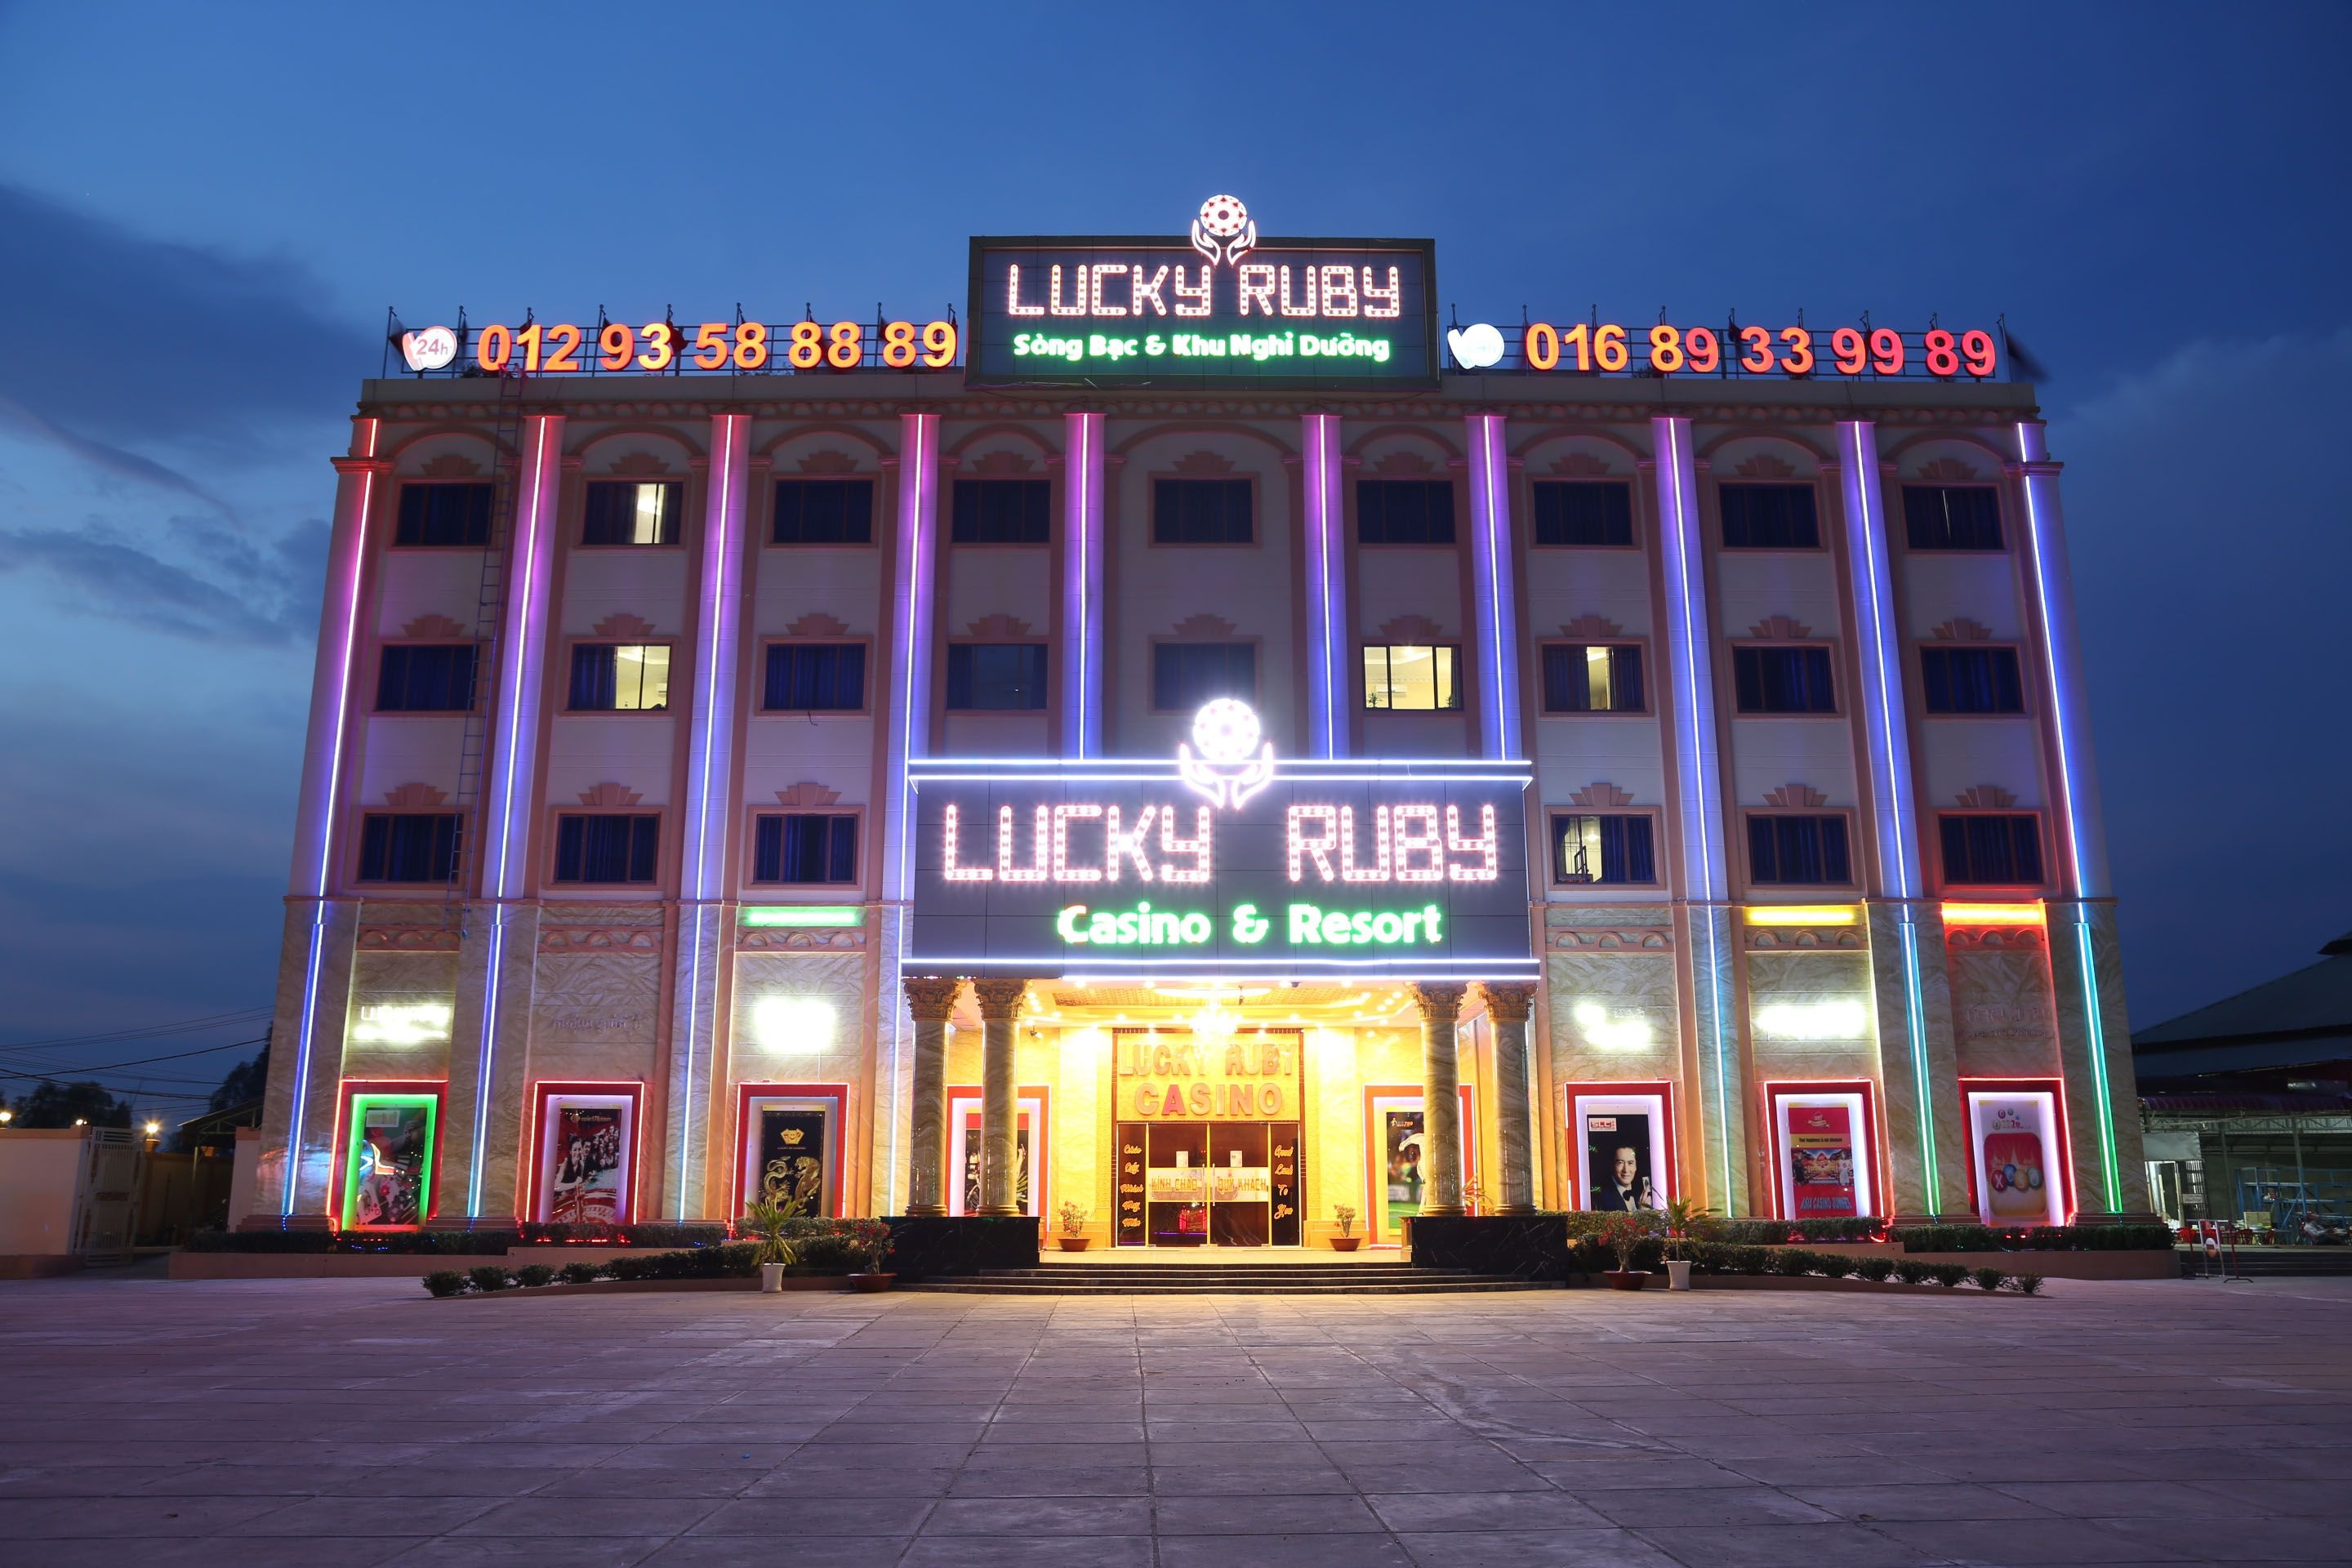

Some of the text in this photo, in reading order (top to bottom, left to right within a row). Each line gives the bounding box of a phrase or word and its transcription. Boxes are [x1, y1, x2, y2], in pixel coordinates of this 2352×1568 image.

[1008, 264, 1401, 318] LUCKY RUBY
[477, 321, 958, 372] 012 93 58 88 89
[1013, 333, 1084, 362] Sòng
[1089, 334, 1138, 361] Bạc
[1145, 334, 1167, 356] &
[1172, 334, 1226, 357] Khu
[1525, 323, 1997, 376] 016 89 33 99 89
[943, 804, 1497, 883] LUCKY RUBY
[1058, 902, 1442, 945] Casino & Resort
[1118, 1044, 1297, 1076] LUCKY RUBY
[1134, 1082, 1283, 1116] CASINO
[1277, 1184, 1289, 1196] To
